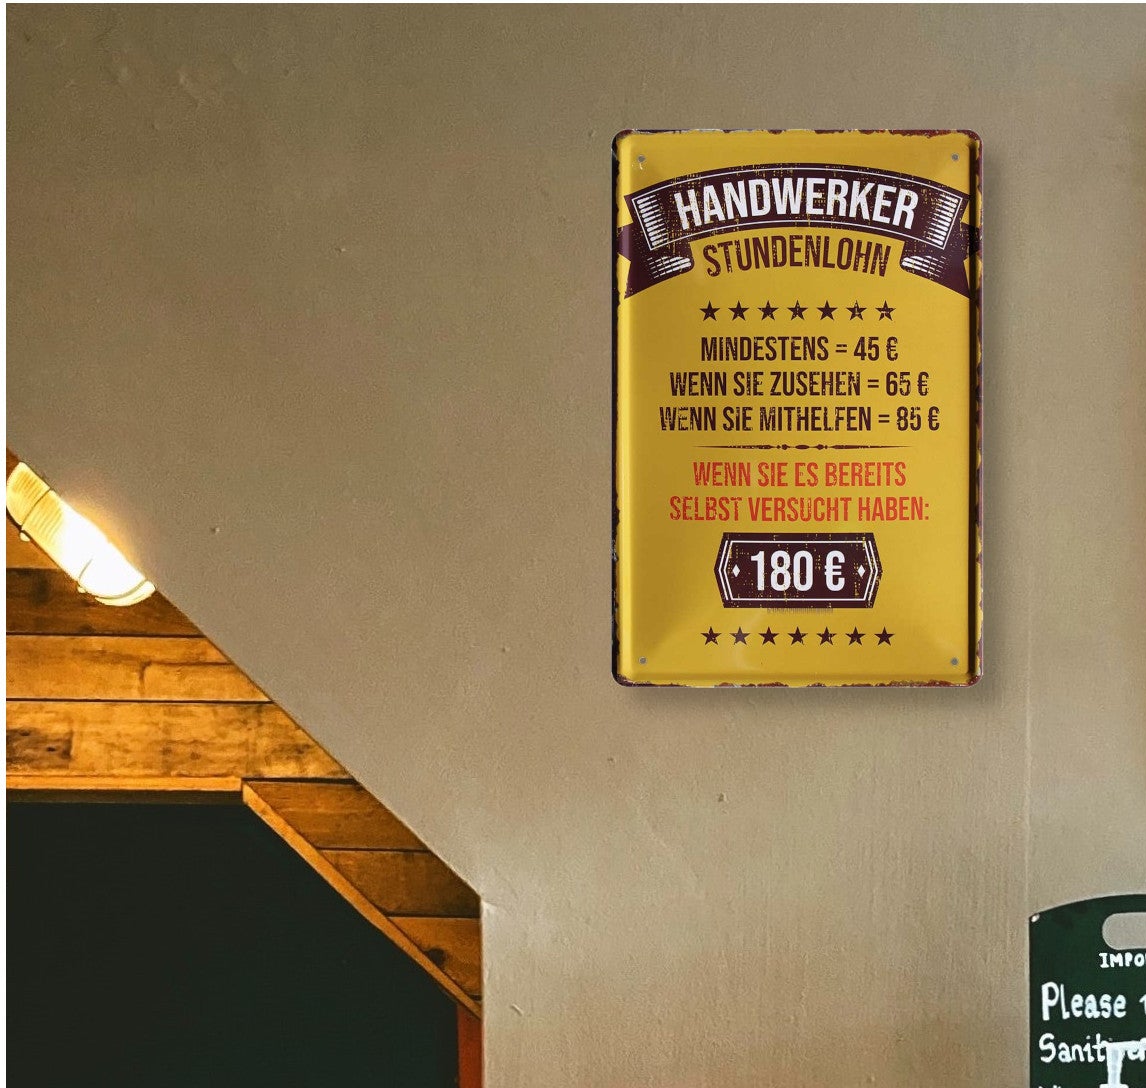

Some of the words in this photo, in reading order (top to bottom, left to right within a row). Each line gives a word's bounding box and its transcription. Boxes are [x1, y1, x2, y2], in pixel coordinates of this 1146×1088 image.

[674, 177, 919, 230] HANDWERKER
[702, 235, 892, 277] STUNDENLOHN
[701, 336, 829, 361] MINDESTENS
[854, 336, 880, 361] 45
[886, 336, 899, 361] €
[670, 371, 727, 397] WENN
[733, 371, 763, 397] SIE
[770, 371, 861, 397] ZUSEHEN
[885, 371, 911, 397] 65
[917, 371, 930, 397] €
[659, 406, 716, 432] WENN
[722, 406, 753, 432] SIE
[759, 406, 872, 432] MITHELFEN
[896, 406, 922, 432] 85
[927, 406, 940, 432] €
[693, 461, 751, 487] WENN
[757, 461, 788, 487] SIE
[795, 461, 819, 487] ES
[825, 461, 907, 487] BEREITS
[669, 495, 743, 522] SELBST
[747, 495, 853, 522] VERSUCHT
[858, 495, 930, 522] HABEN:
[750, 550, 814, 592] 180
[824, 550, 845, 592] €
[1041, 981, 1127, 1021] Please
